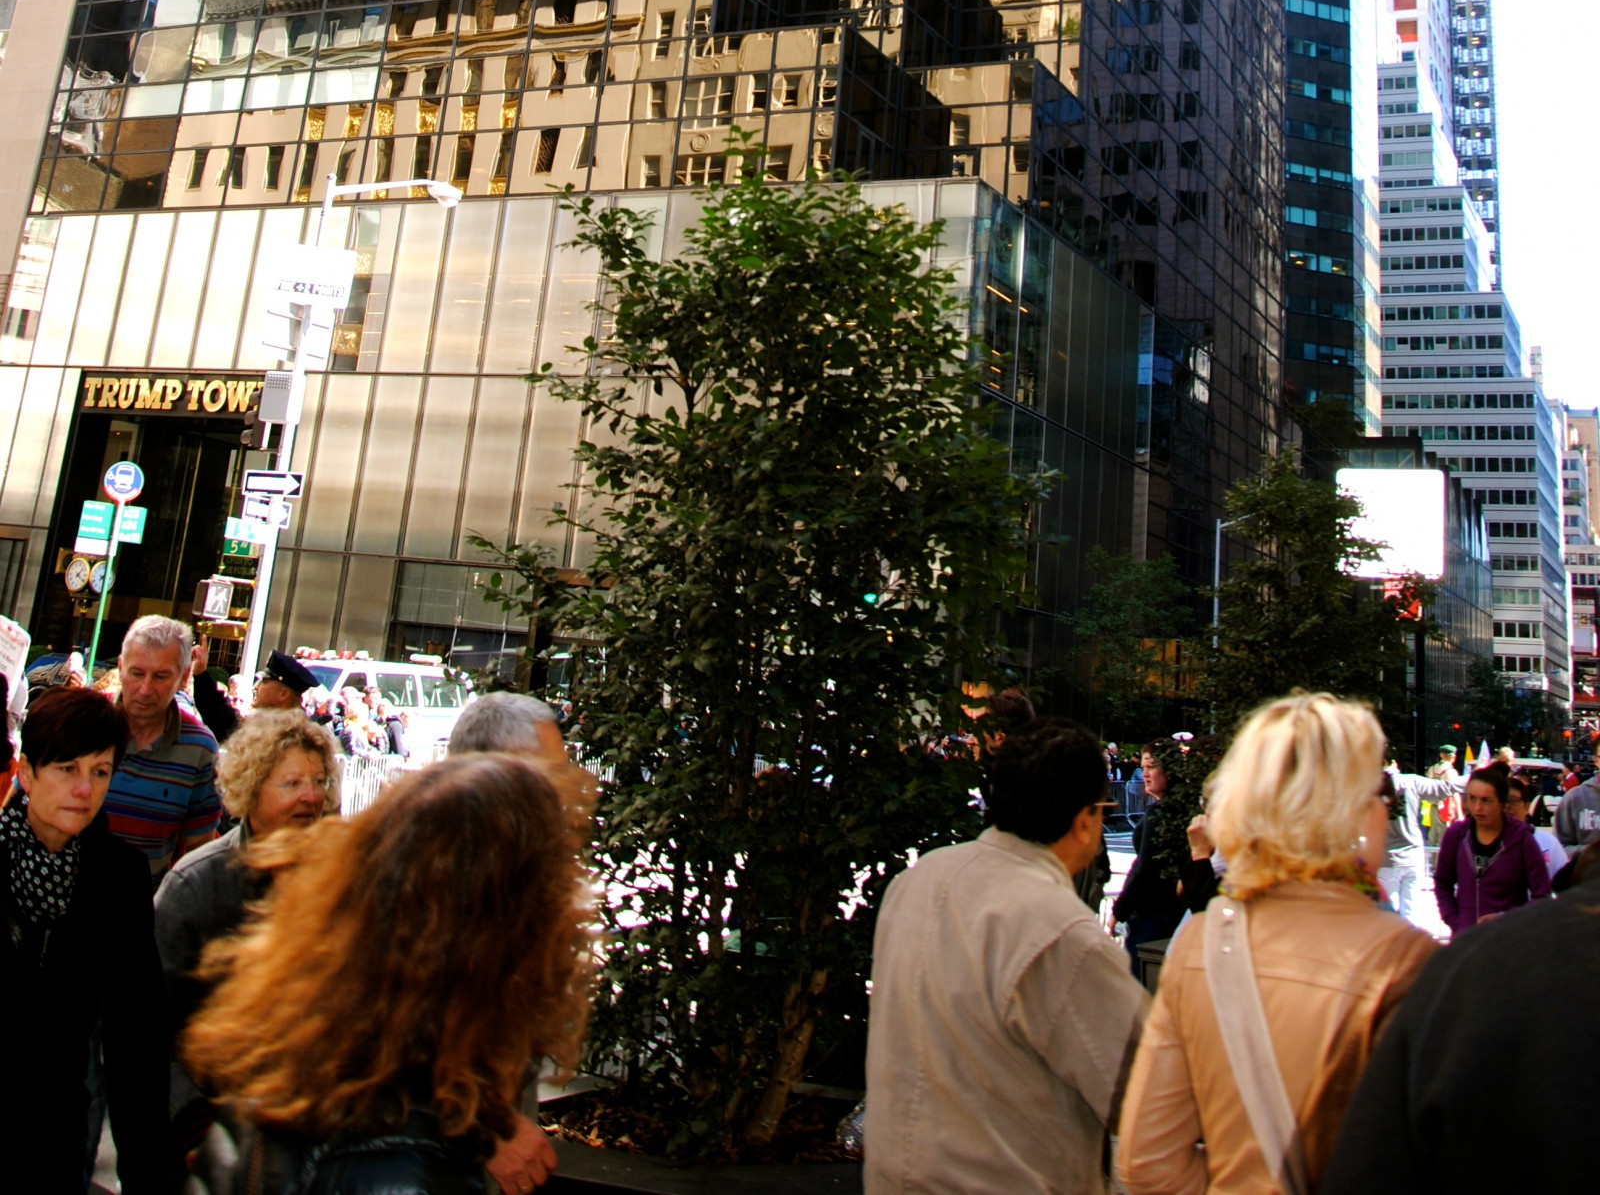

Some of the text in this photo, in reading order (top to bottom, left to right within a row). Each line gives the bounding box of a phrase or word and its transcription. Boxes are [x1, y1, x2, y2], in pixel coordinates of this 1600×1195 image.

[84, 377, 265, 413] TRUMP TOW
[230, 540, 238, 553] 5
